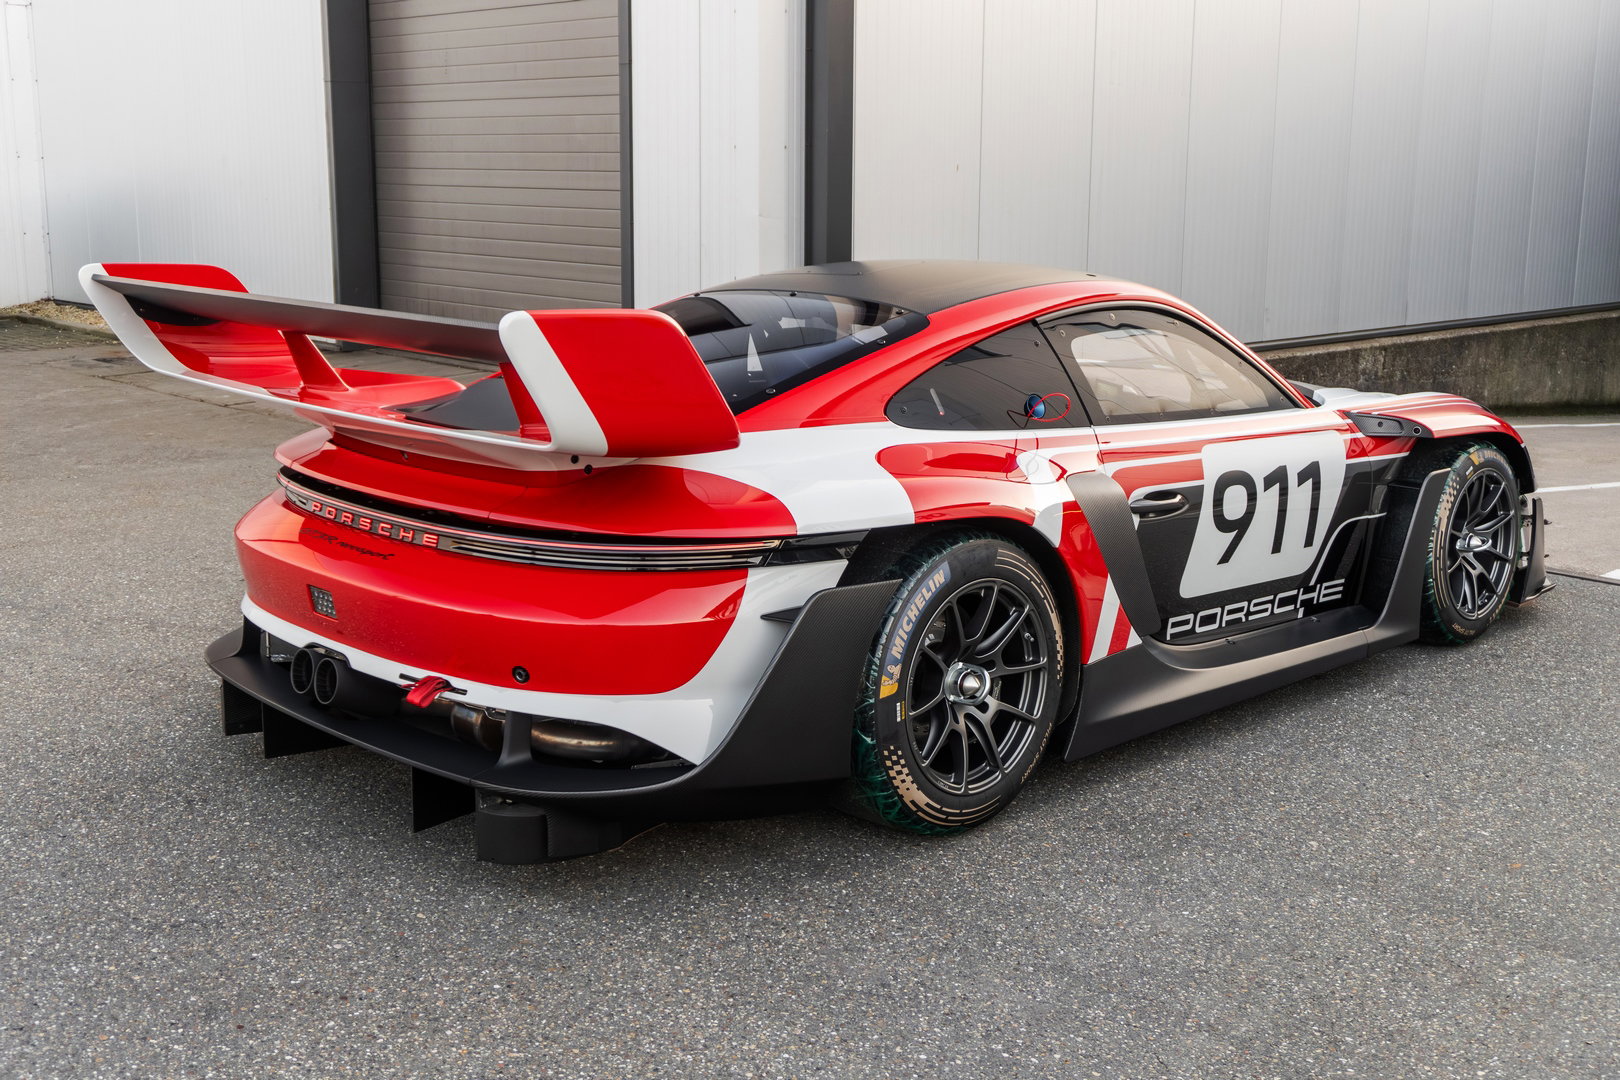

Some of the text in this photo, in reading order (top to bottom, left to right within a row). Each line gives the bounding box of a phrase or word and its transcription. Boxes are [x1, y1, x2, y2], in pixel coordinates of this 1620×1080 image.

[310, 501, 439, 547] PORSCHE
[1213, 461, 1321, 565] 911
[891, 569, 946, 659] MICHELIN
[1166, 578, 1345, 641] PORSCHE
